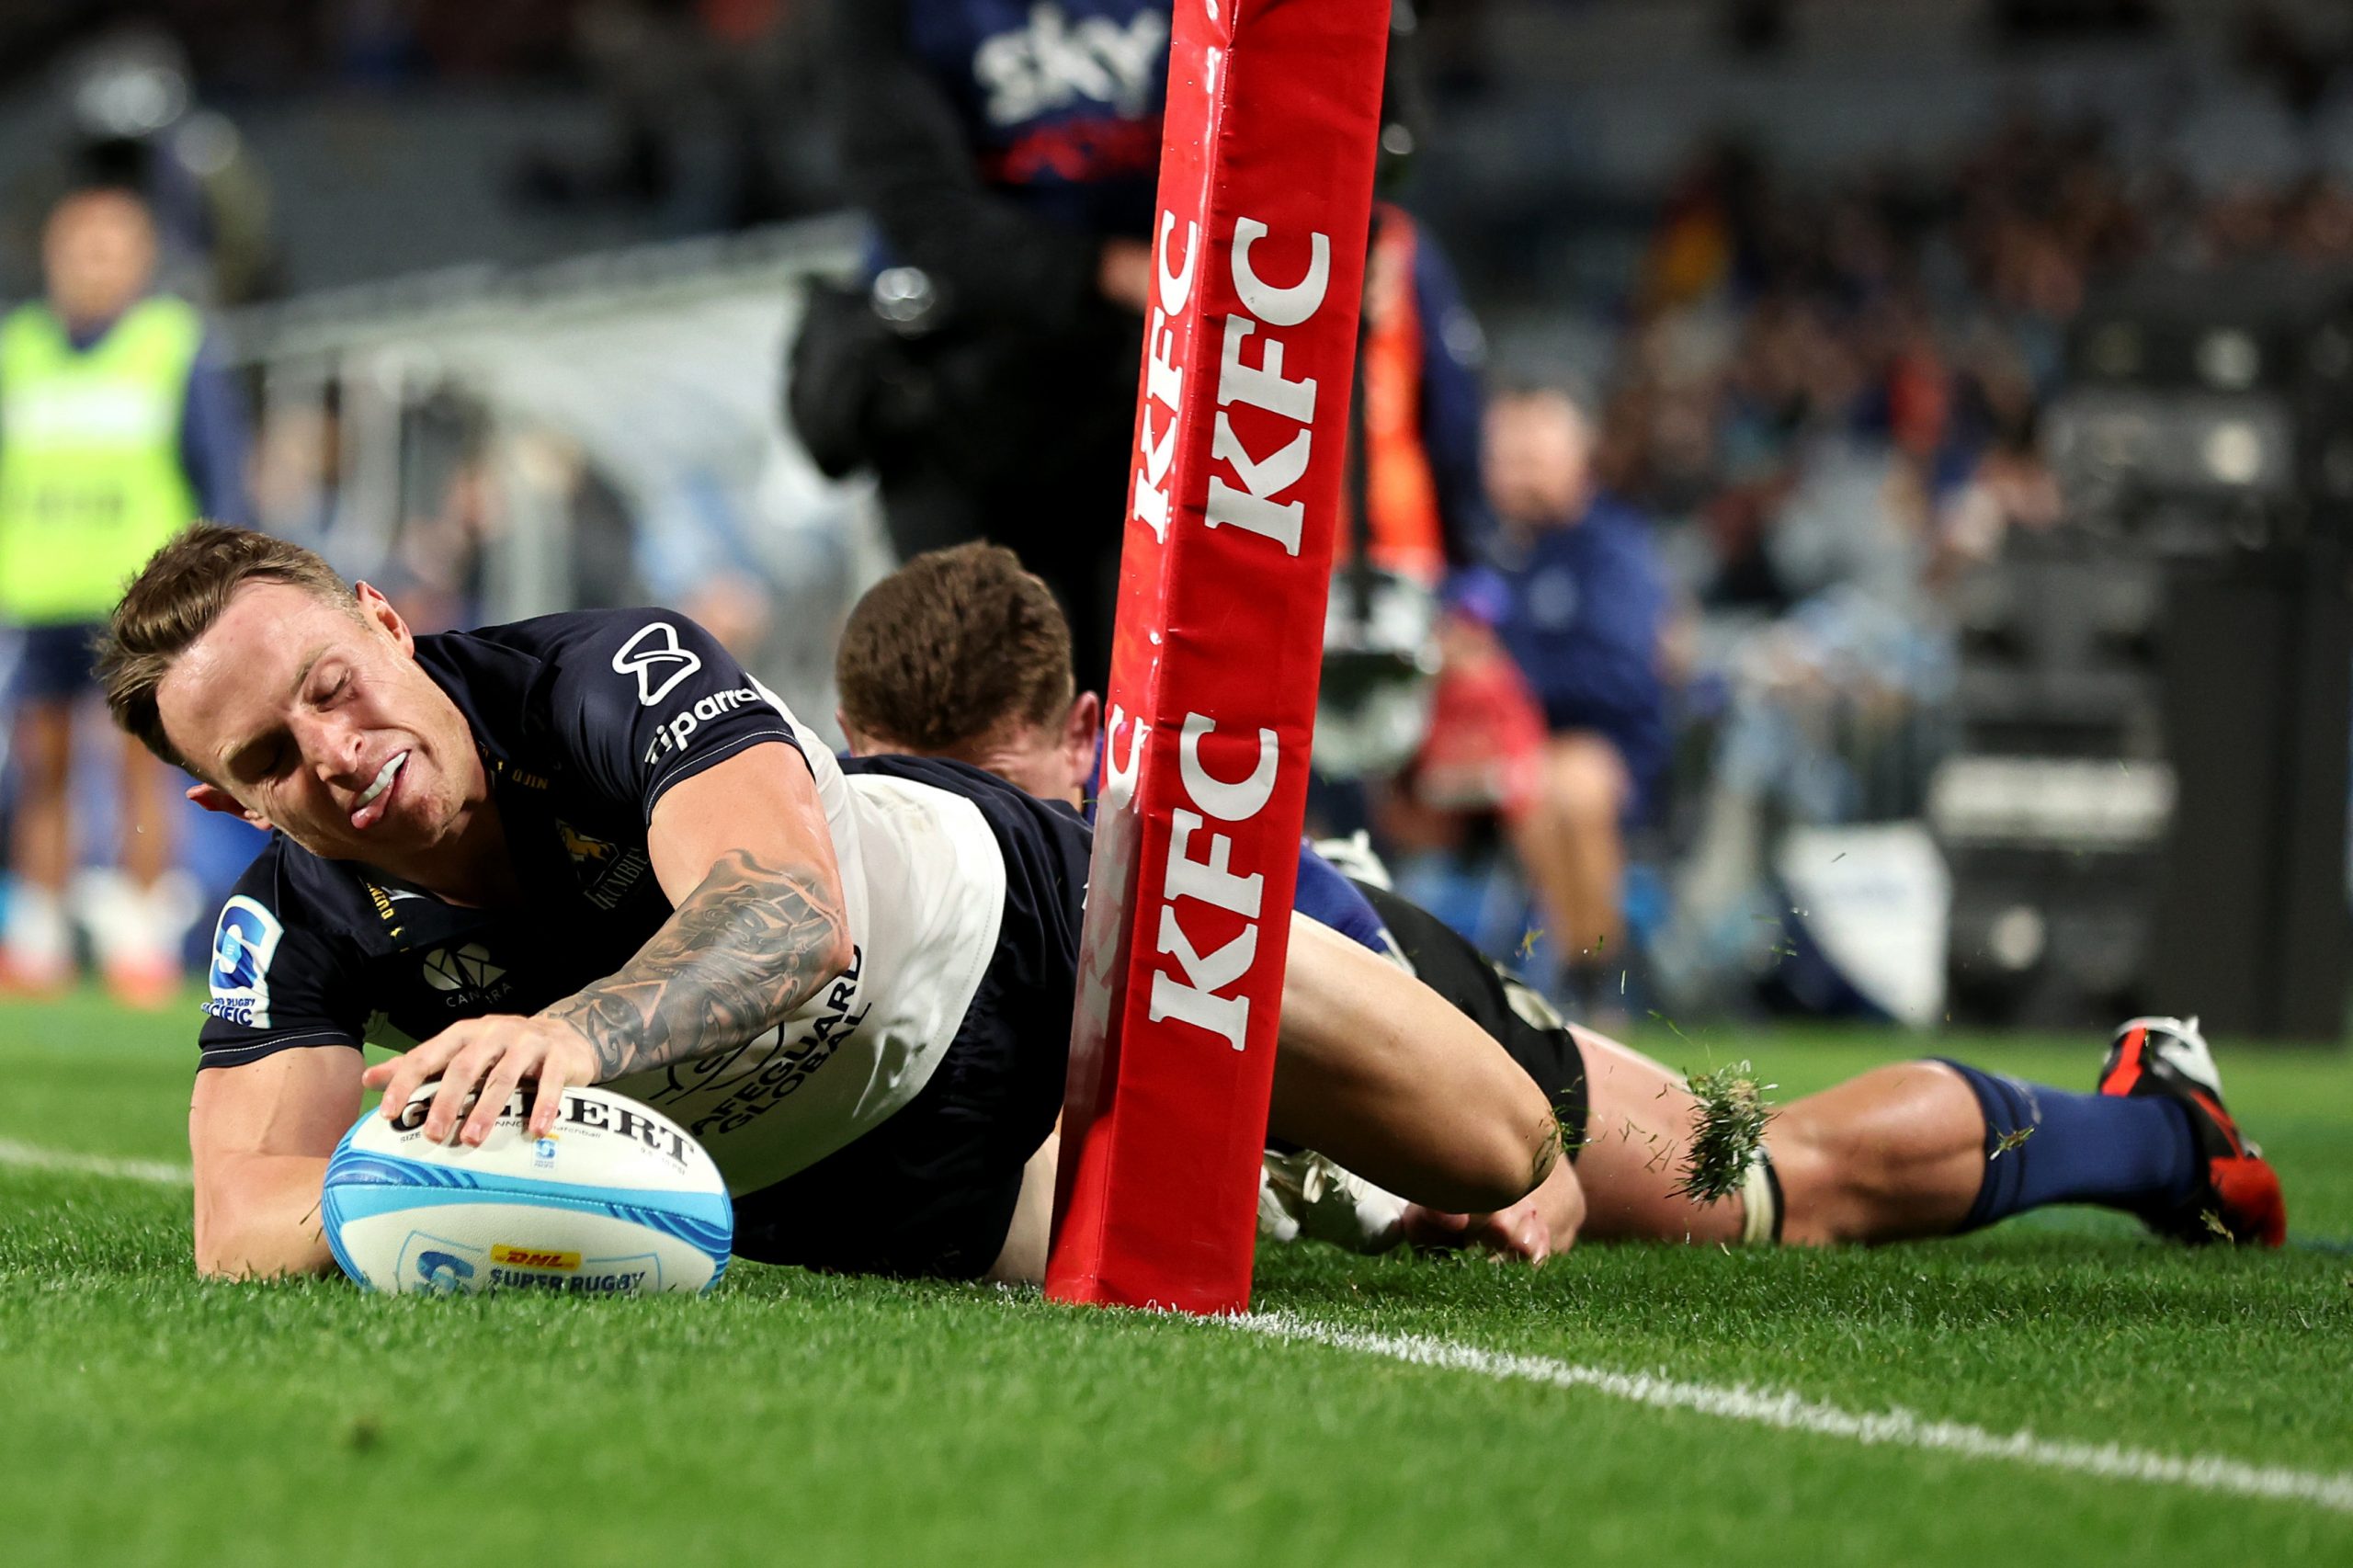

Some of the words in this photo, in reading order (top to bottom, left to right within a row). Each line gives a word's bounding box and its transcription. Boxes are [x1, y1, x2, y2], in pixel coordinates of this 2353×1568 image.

[1132, 209, 1196, 544] KFC
[1204, 216, 1330, 557] KFC
[1148, 711, 1279, 1051] KFC
[201, 1004, 253, 1027] CIFIC
[691, 945, 861, 1136] AFEGUARD
[719, 1002, 871, 1133] GLOBAL
[400, 1131, 421, 1142] SIZE
[506, 1250, 563, 1267] DHL
[574, 1271, 646, 1291] RUGBY
